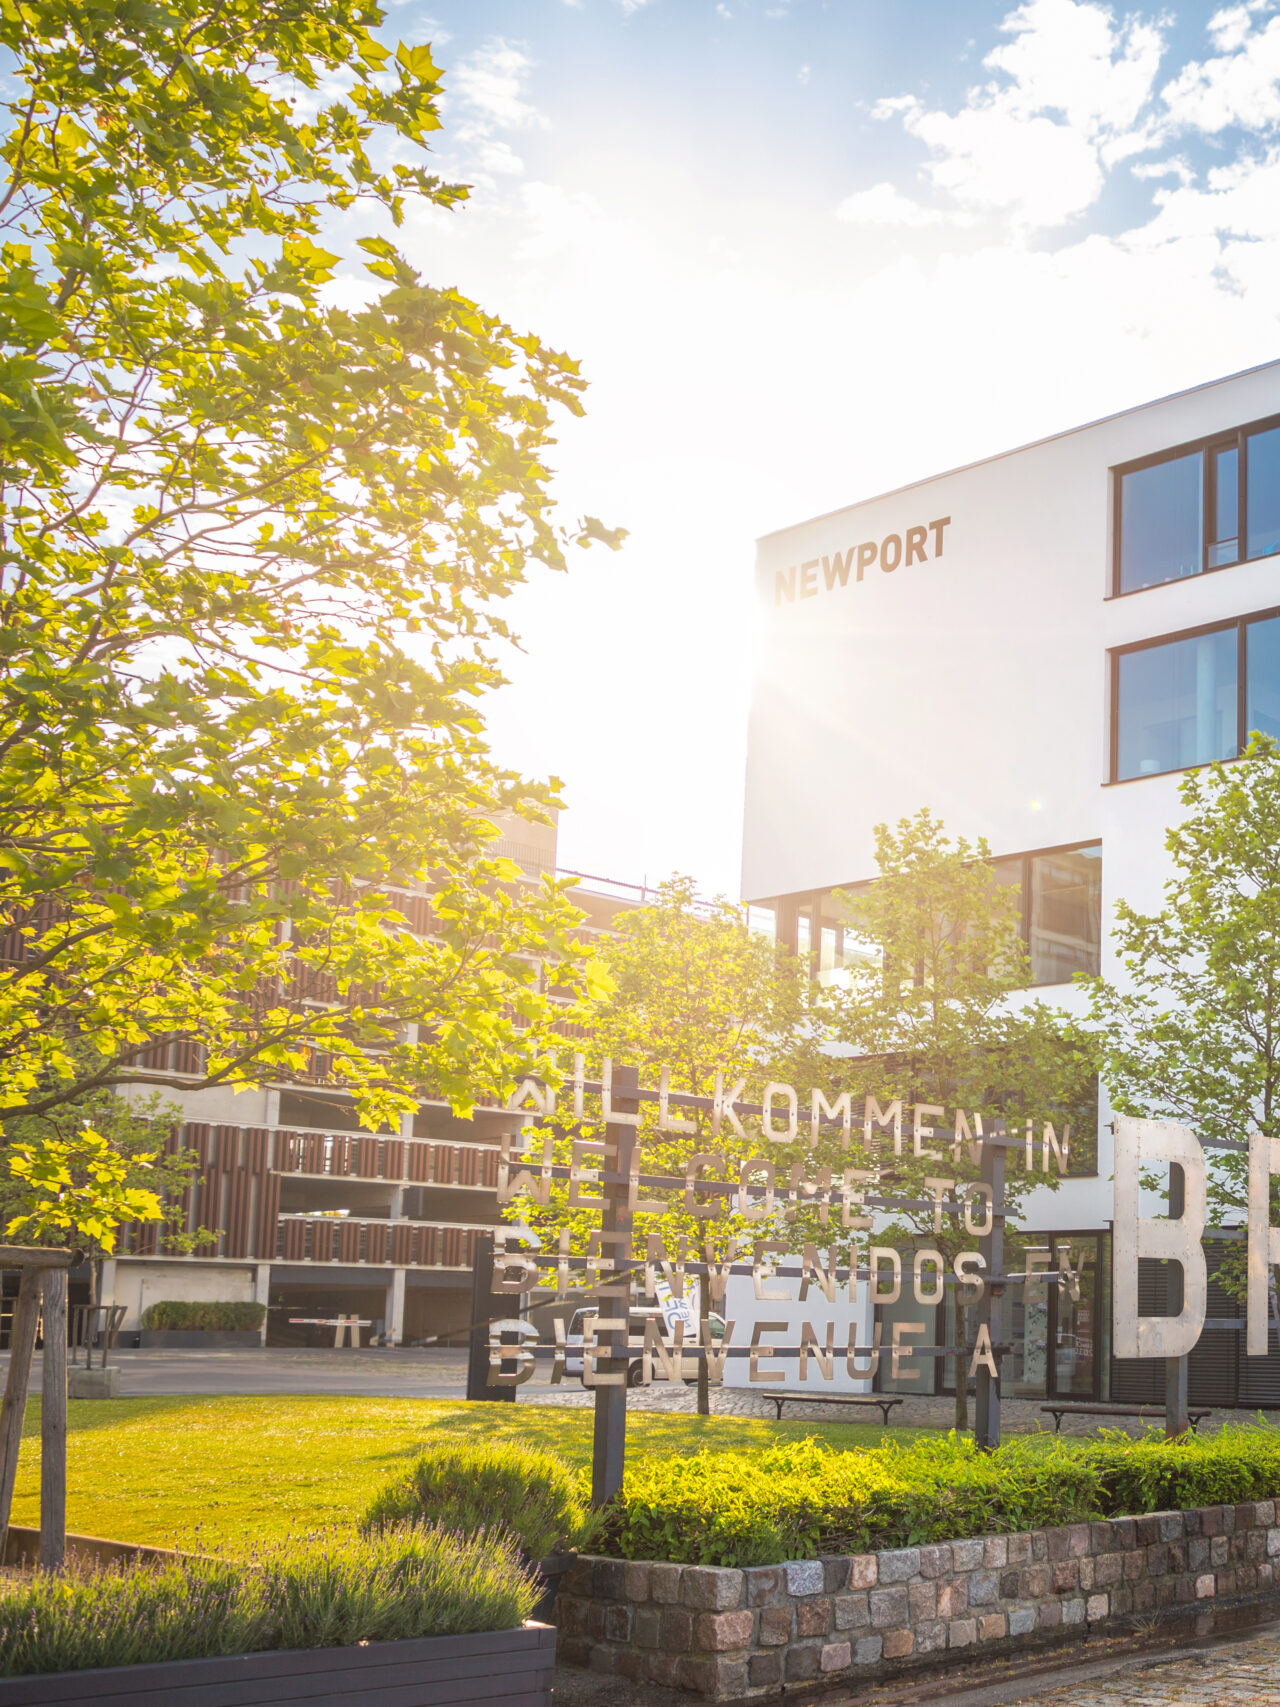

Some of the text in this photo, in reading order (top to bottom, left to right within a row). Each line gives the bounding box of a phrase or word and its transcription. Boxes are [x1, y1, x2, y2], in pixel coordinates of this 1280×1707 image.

[774, 515, 951, 608] NEWPORT
[497, 1133, 993, 1236] WELCOME TO
[1026, 1118, 1071, 1174] IN
[489, 1226, 1085, 1306] BIENVENIDOS EN
[486, 1317, 999, 1386] BIENVENUE A
